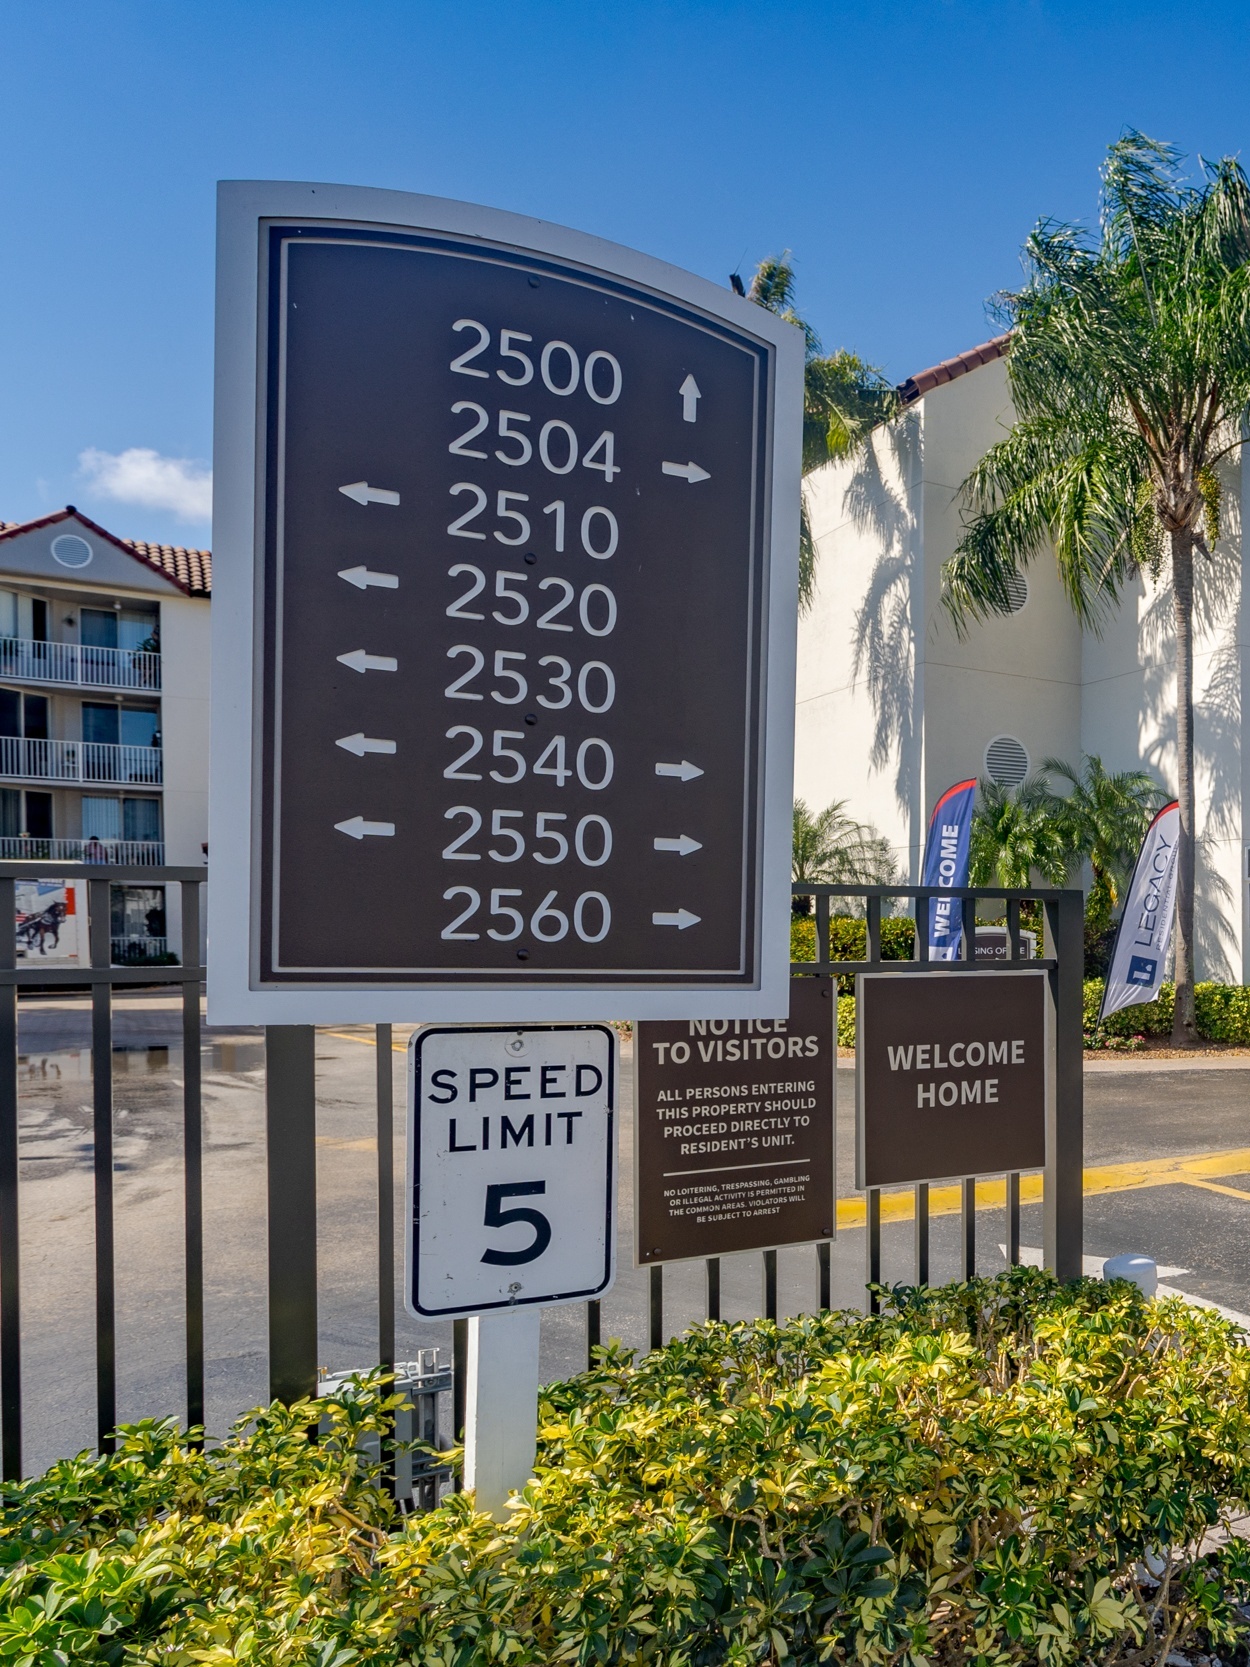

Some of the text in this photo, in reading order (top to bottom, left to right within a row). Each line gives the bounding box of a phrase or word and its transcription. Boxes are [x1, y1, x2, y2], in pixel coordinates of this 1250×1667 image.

[449, 318, 623, 406] 2500
[448, 400, 620, 483] 2504
[447, 481, 619, 560] 2510
[446, 563, 617, 637] 2520
[444, 644, 616, 714] 2530
[443, 725, 614, 790] 2540
[441, 805, 613, 867] 2550
[933, 824, 959, 938] WELCOME
[1134, 833, 1172, 947] LEGACY
[440, 885, 612, 943] 2560
[958, 947, 1025, 955] LSING OFE
[689, 1019, 787, 1036] NOTICE
[652, 1035, 819, 1065] TO VISITORS
[887, 1039, 1026, 1071] WELCOME
[428, 1064, 603, 1105] SPEED
[657, 1080, 815, 1102] ALL PERSONS ENTERING
[917, 1078, 999, 1108] HOME
[656, 1097, 817, 1120] THIS PROPERTY SHOULD
[663, 1115, 810, 1138] PROCEED DIRECTLY TO
[448, 1111, 583, 1153] LIMIT
[680, 1134, 795, 1155] RESIDENT’S UNIT.
[664, 1175, 811, 1197] NO LOITERING, TRESPASSING, GAMBLING
[669, 1199, 681, 1207] OR
[683, 1196, 713, 1205] ILLEGAL
[714, 1191, 747, 1202] ACTIVITY
[747, 1190, 755, 1198] IS
[756, 1186, 797, 1197] PERMITTED
[480, 1180, 552, 1266] 5
[669, 1194, 806, 1217] THE COMMON AREAS. VIOLATORS WILL
[696, 1206, 781, 1223] BE SUBJECT TO ARREST
